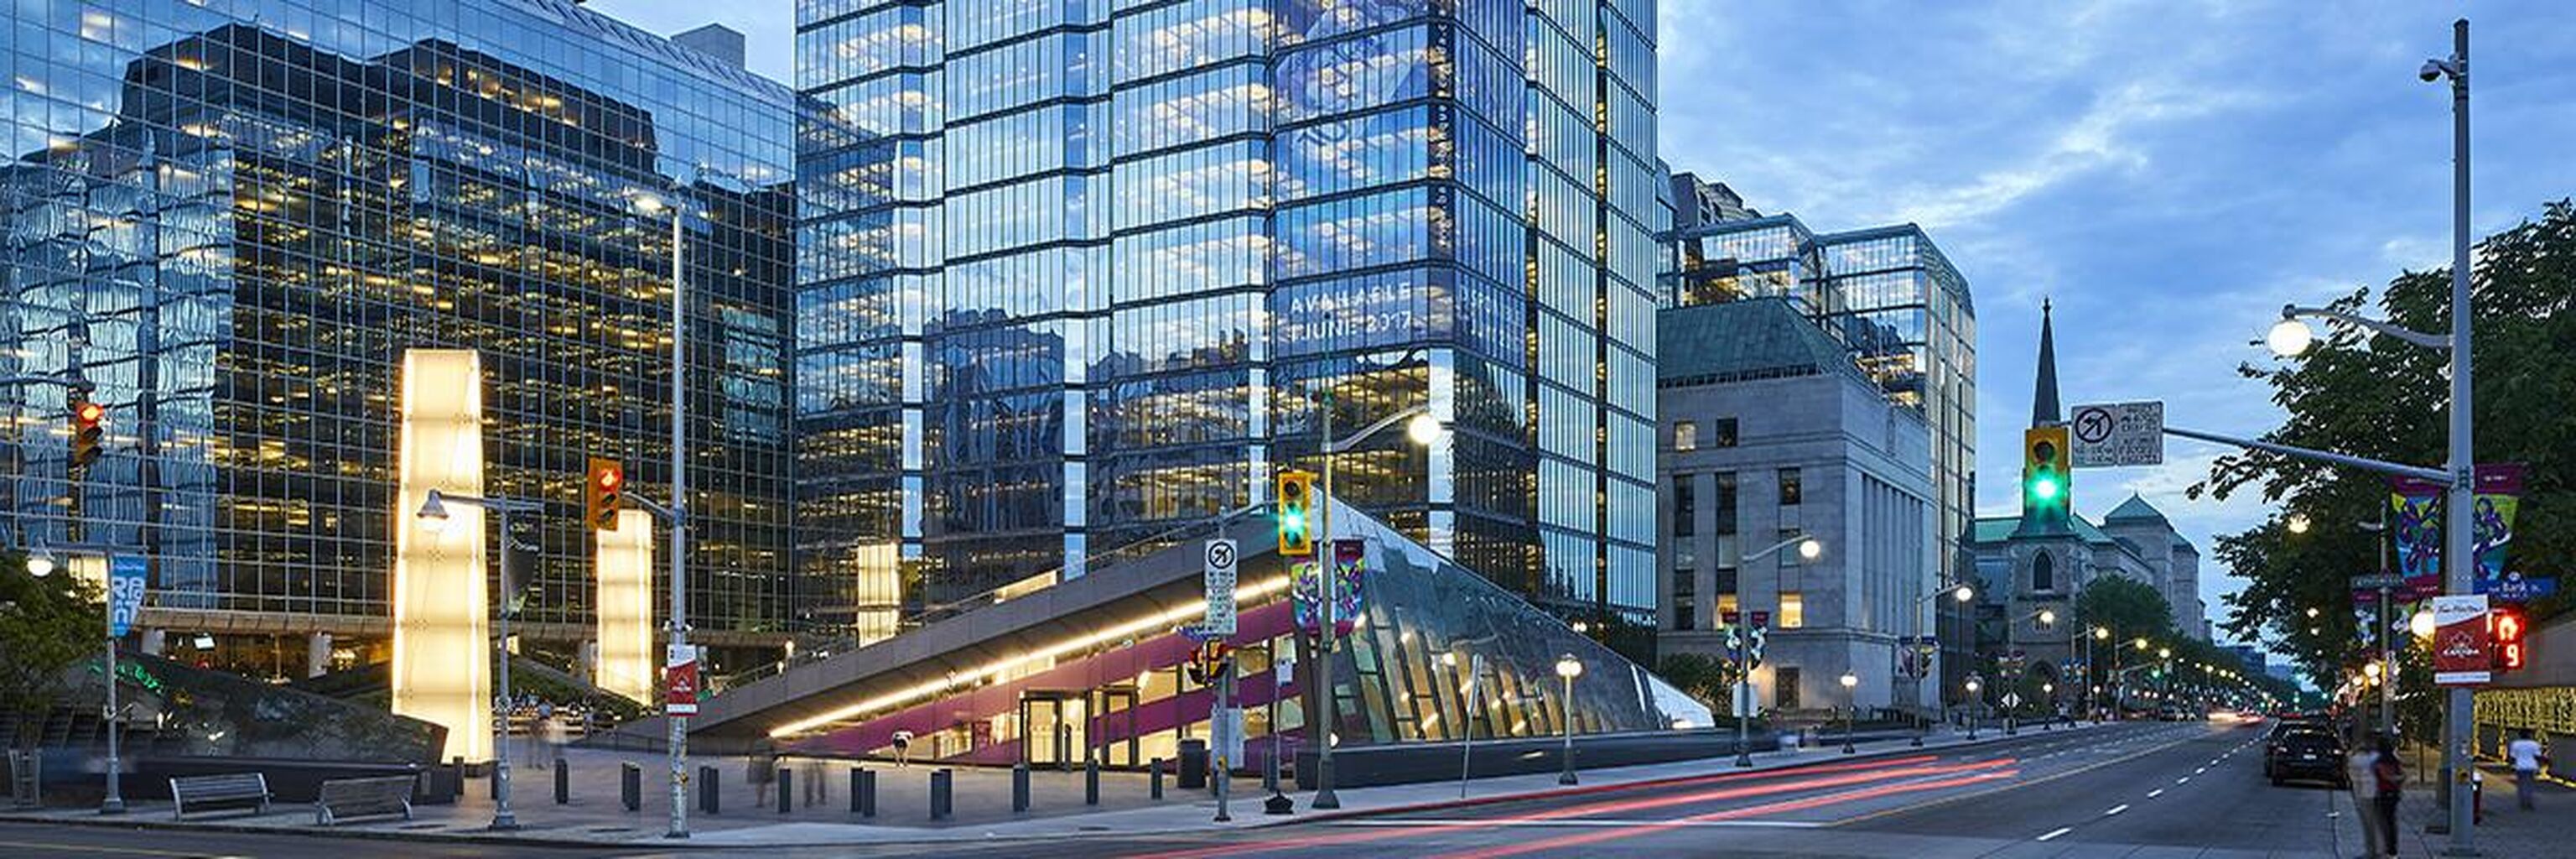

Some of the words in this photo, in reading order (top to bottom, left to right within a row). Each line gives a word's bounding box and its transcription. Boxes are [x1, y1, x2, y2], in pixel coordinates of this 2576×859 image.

[1291, 281, 1411, 314] AVAILABLE
[1367, 310, 1411, 333] 2017
[2506, 643, 2520, 667] 9
